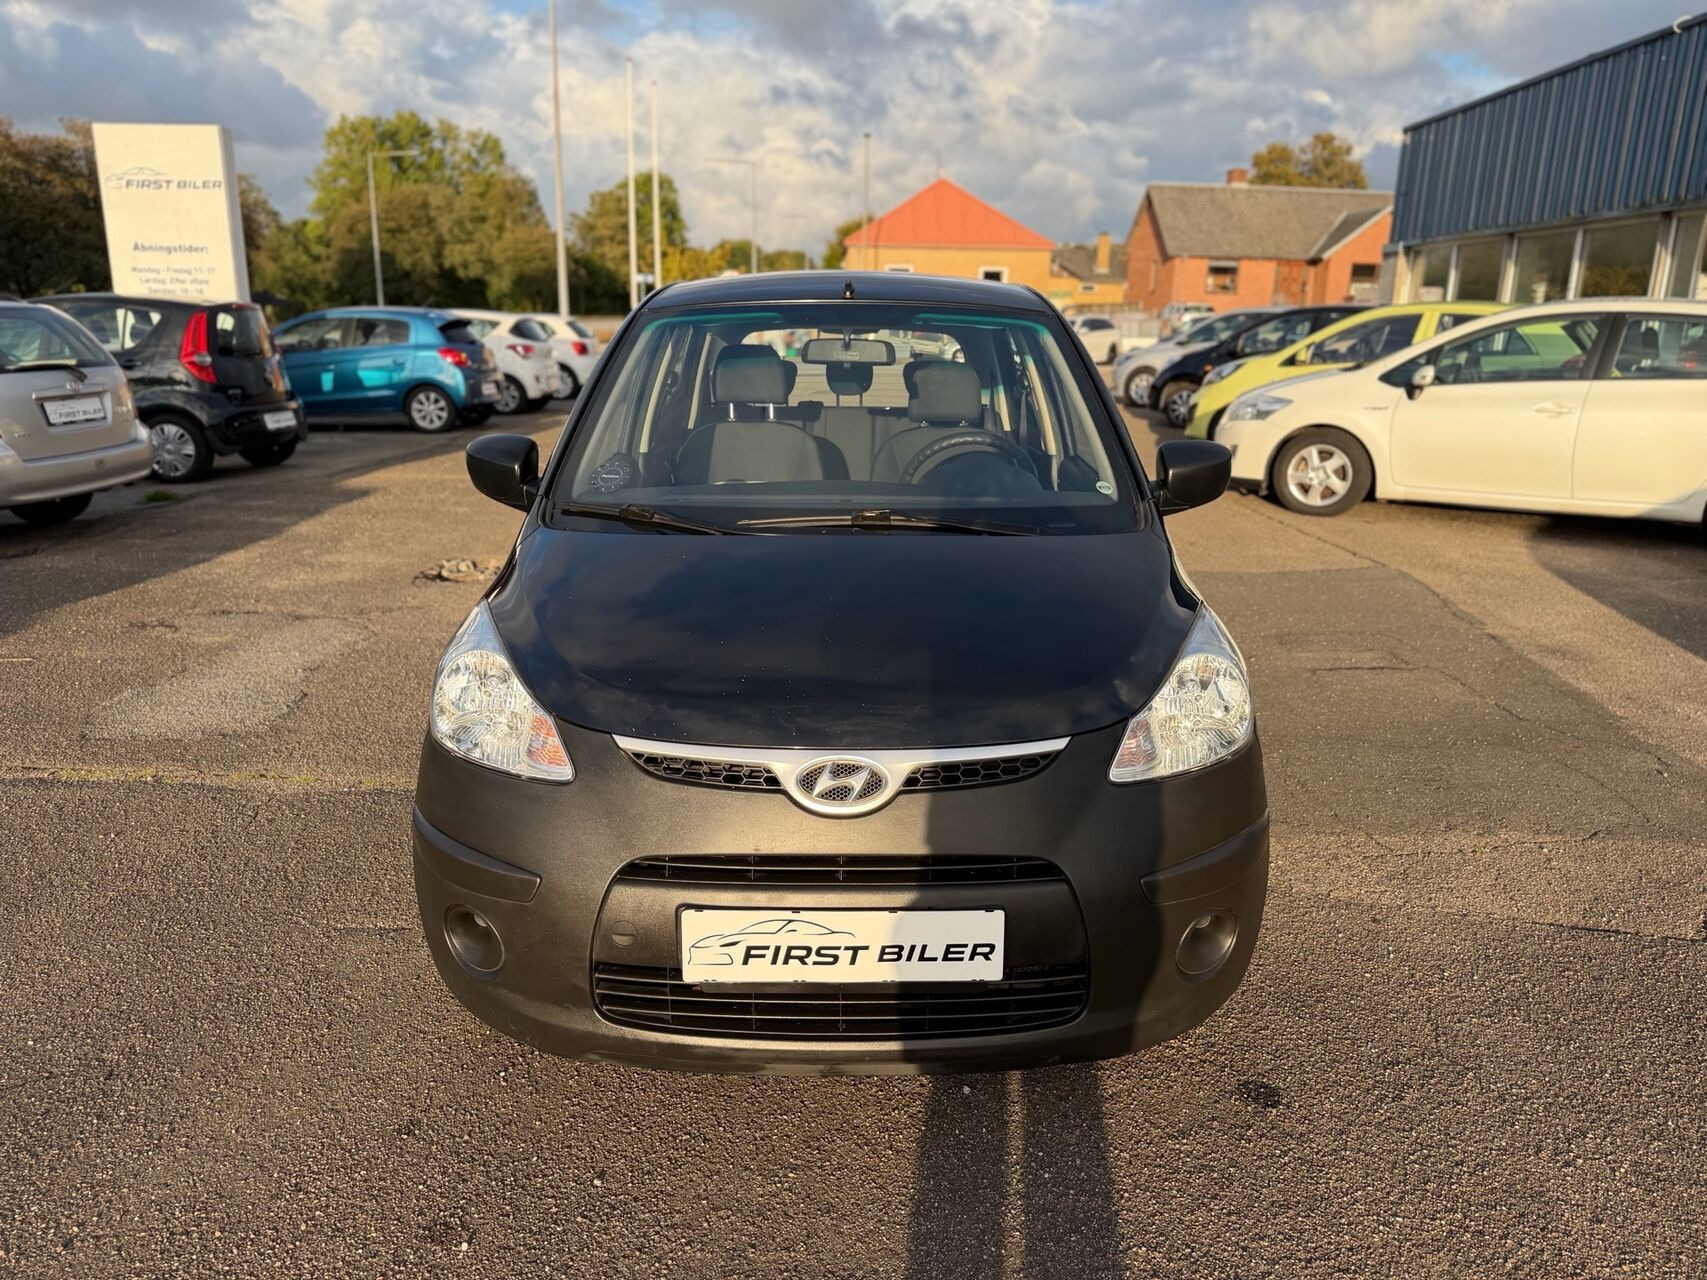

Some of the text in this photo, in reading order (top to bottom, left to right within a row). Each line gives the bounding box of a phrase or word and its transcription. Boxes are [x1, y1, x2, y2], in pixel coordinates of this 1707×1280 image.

[125, 178, 223, 190] FIRST BILER
[741, 942, 996, 966] FIRST BILER
